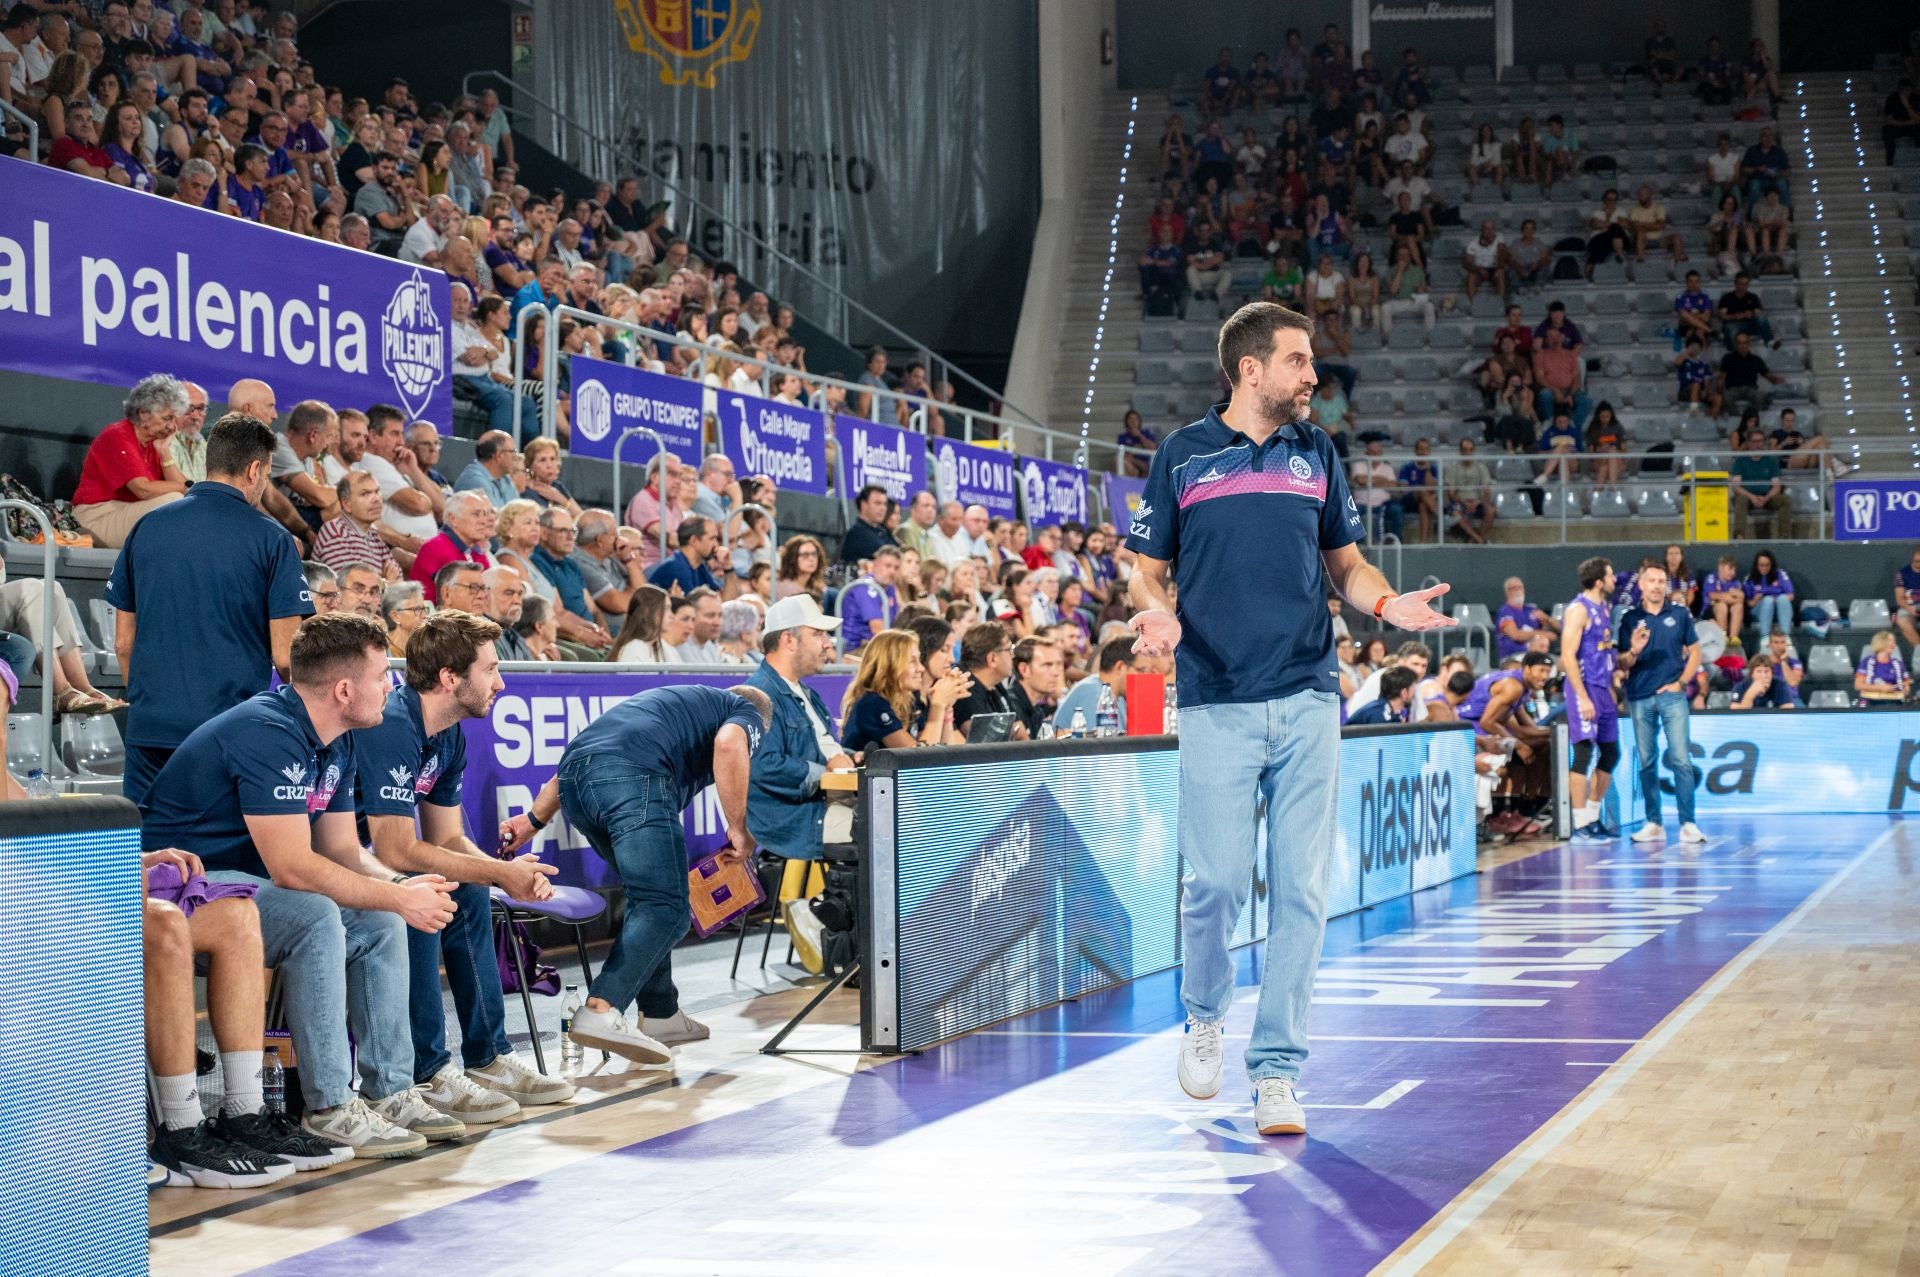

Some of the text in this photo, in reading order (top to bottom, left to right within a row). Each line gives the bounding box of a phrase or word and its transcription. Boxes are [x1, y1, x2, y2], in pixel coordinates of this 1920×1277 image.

[81, 252, 369, 374] palencia
[384, 323, 441, 371] PALENCIA
[613, 392, 700, 431] GRUPO TECNIPEC
[760, 408, 811, 445] Calle Mayor
[741, 421, 813, 485] Ortopedia
[959, 456, 1013, 494] DIONI
[1359, 745, 1452, 905] plaspisa
